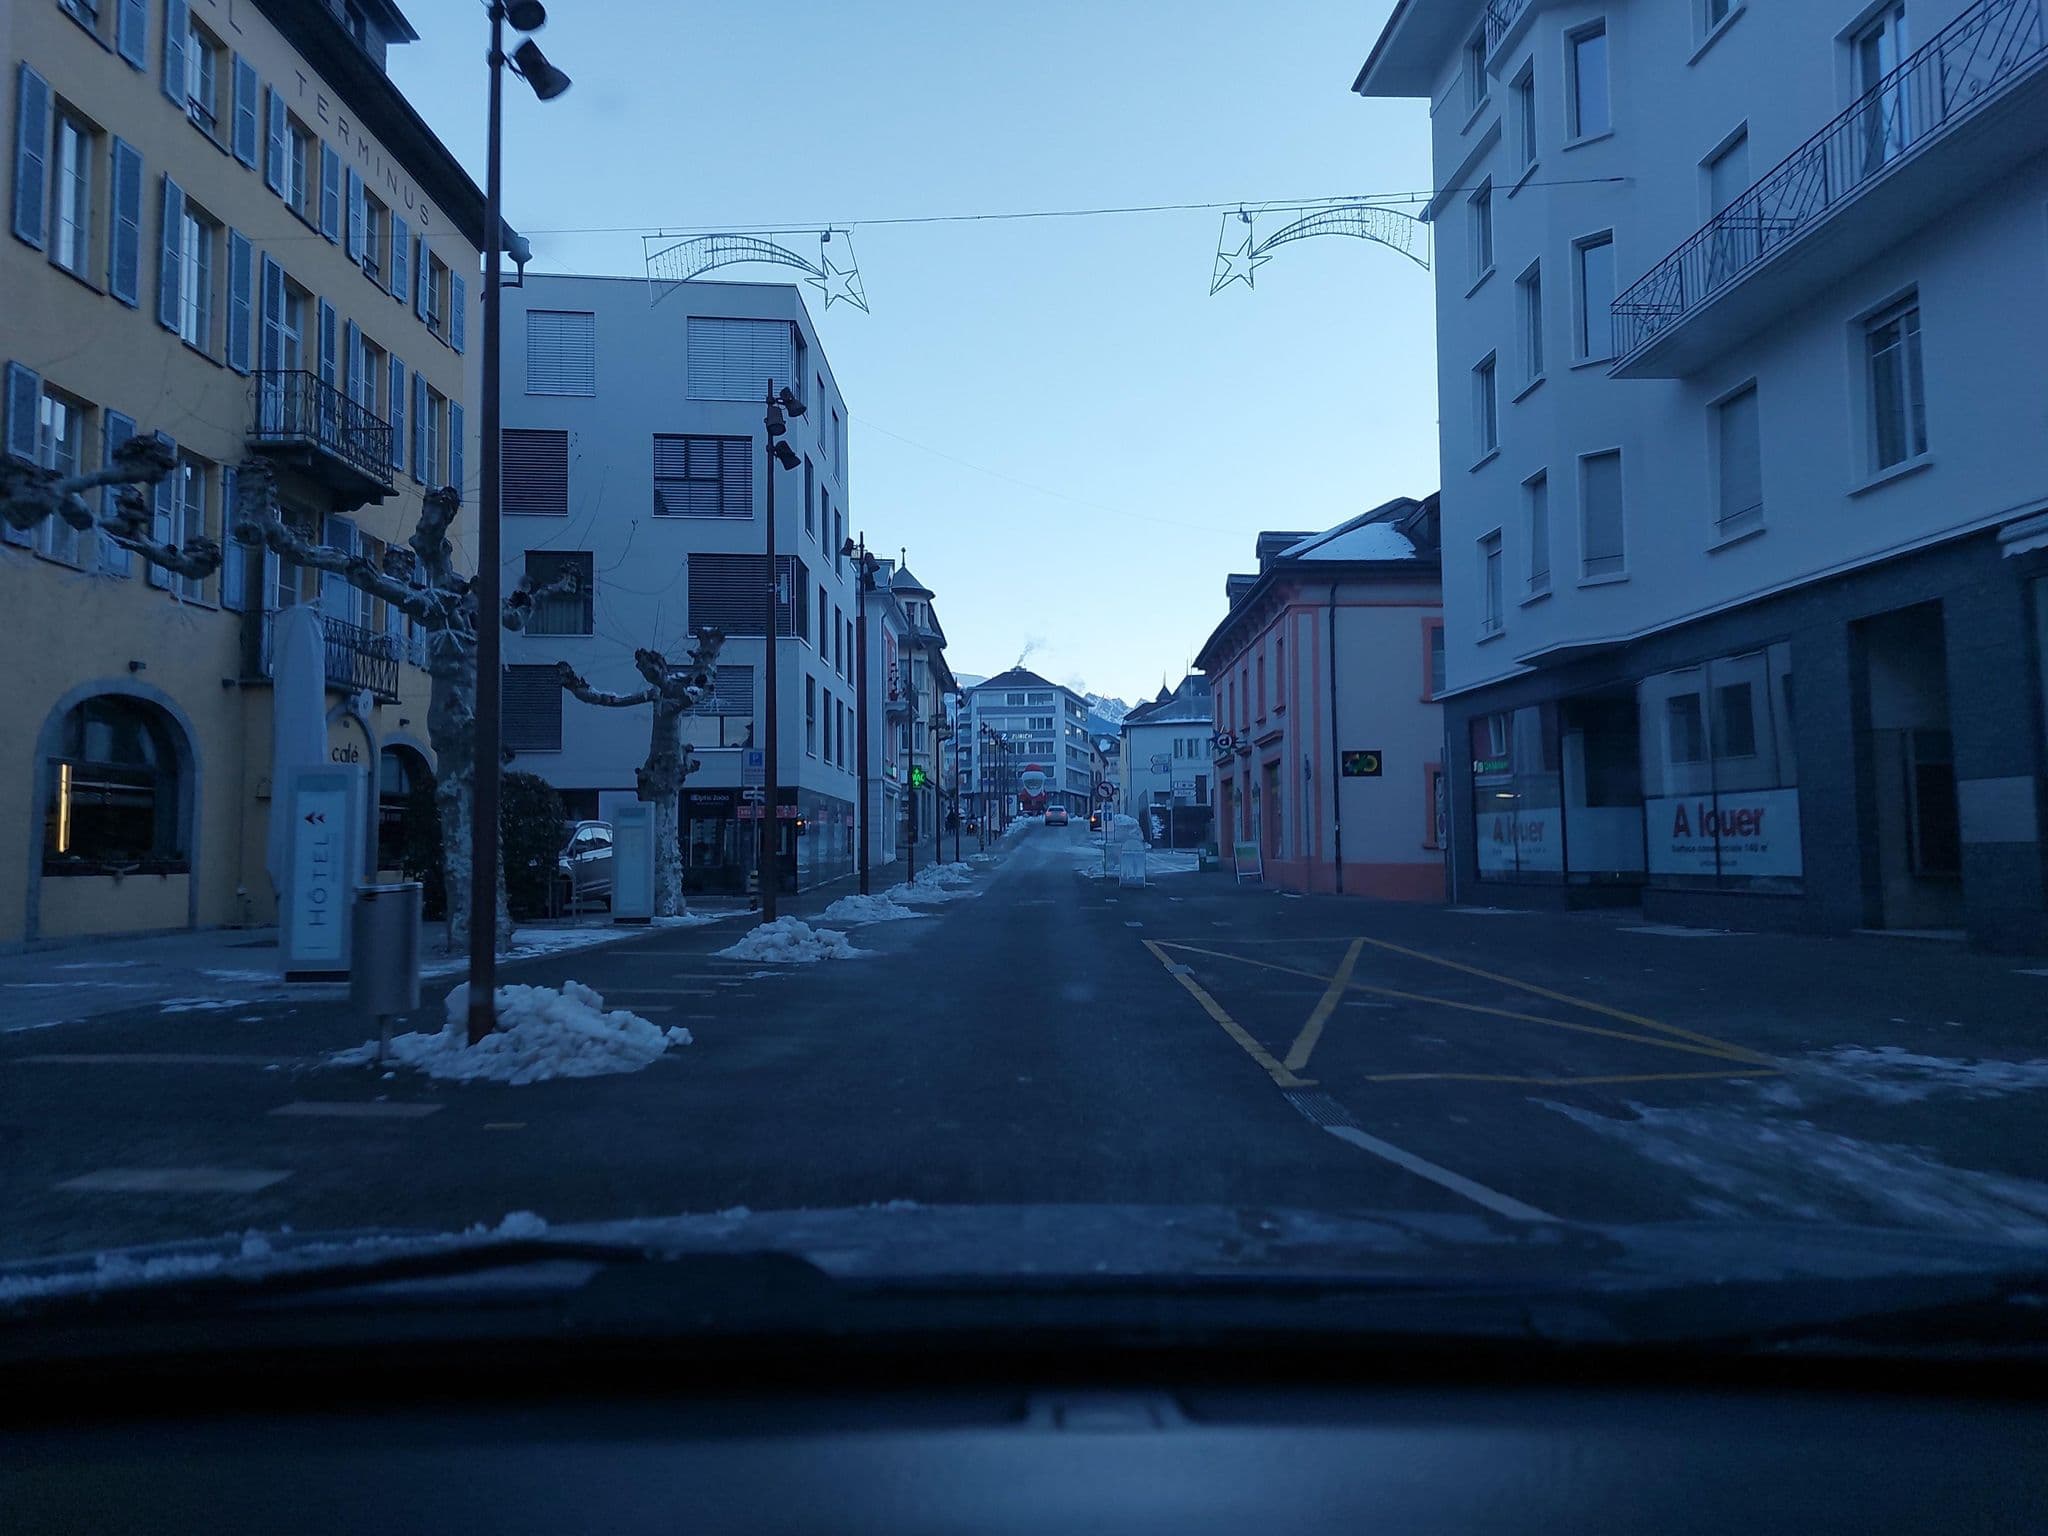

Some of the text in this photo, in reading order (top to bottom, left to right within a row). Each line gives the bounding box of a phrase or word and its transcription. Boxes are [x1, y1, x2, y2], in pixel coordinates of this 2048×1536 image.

[295, 70, 430, 226] TERMINUS
[1672, 802, 1766, 838] A louer
